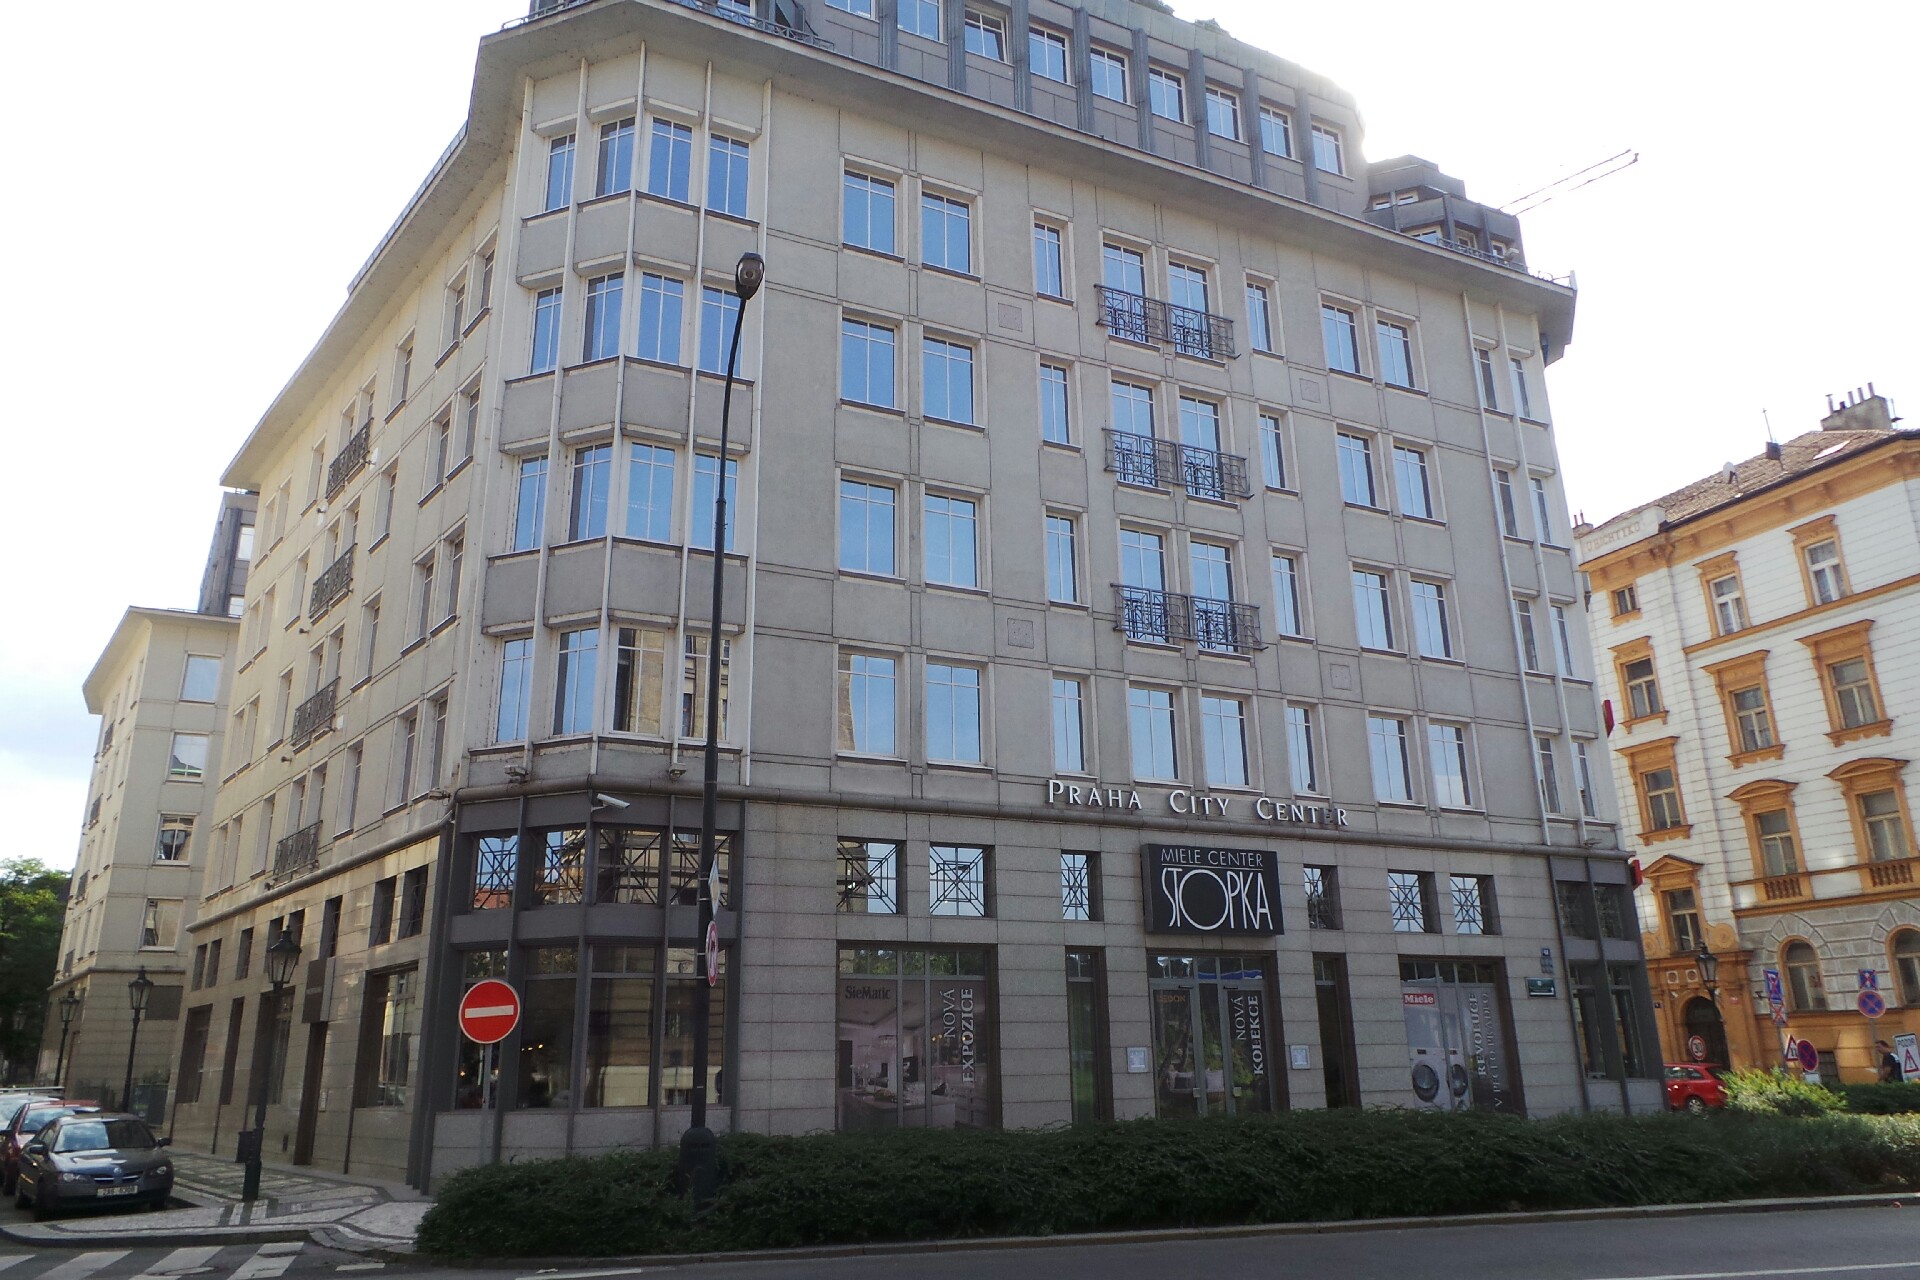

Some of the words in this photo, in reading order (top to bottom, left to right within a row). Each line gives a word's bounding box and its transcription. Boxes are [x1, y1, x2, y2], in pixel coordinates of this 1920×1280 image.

[1048, 779, 1142, 810] PRAHA
[1169, 789, 1230, 816] CITY
[1256, 797, 1349, 826] CENTER
[1161, 848, 1201, 864] MIELE
[1208, 851, 1263, 867] CENTER
[1161, 867, 1273, 931] STOPKA
[845, 985, 891, 999] SieMatic
[940, 988, 956, 1039] NOVÁ
[1404, 994, 1434, 1004] Miele
[961, 988, 975, 1084] EXPOZICE
[1231, 996, 1247, 1040] NOVÁ
[1248, 995, 1264, 1076] KOLEKCE
[1469, 993, 1487, 1076] REVOLUCE
